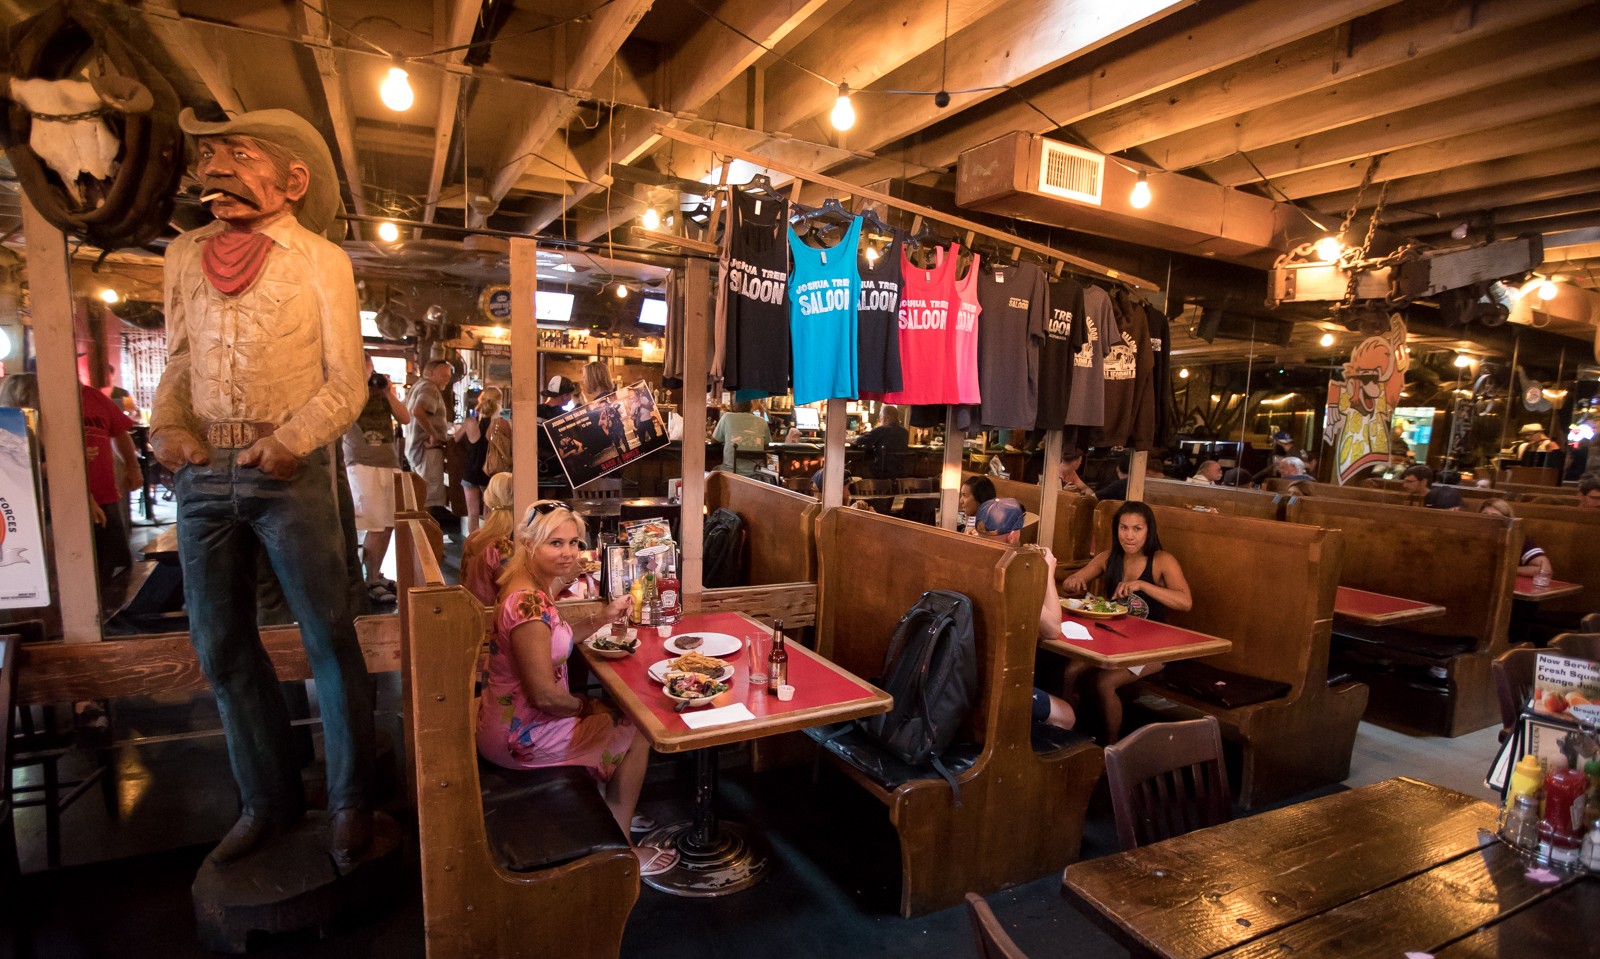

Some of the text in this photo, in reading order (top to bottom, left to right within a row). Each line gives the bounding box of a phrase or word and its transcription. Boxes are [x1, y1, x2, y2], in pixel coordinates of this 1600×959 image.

[762, 269, 786, 281] TREE
[796, 278, 850, 294] JOSHUA TRE
[0, 497, 17, 533] FORCES
[1540, 656, 1560, 665] Now
[1538, 665, 1566, 676] Fresh
[1538, 674, 1574, 686] Orange
